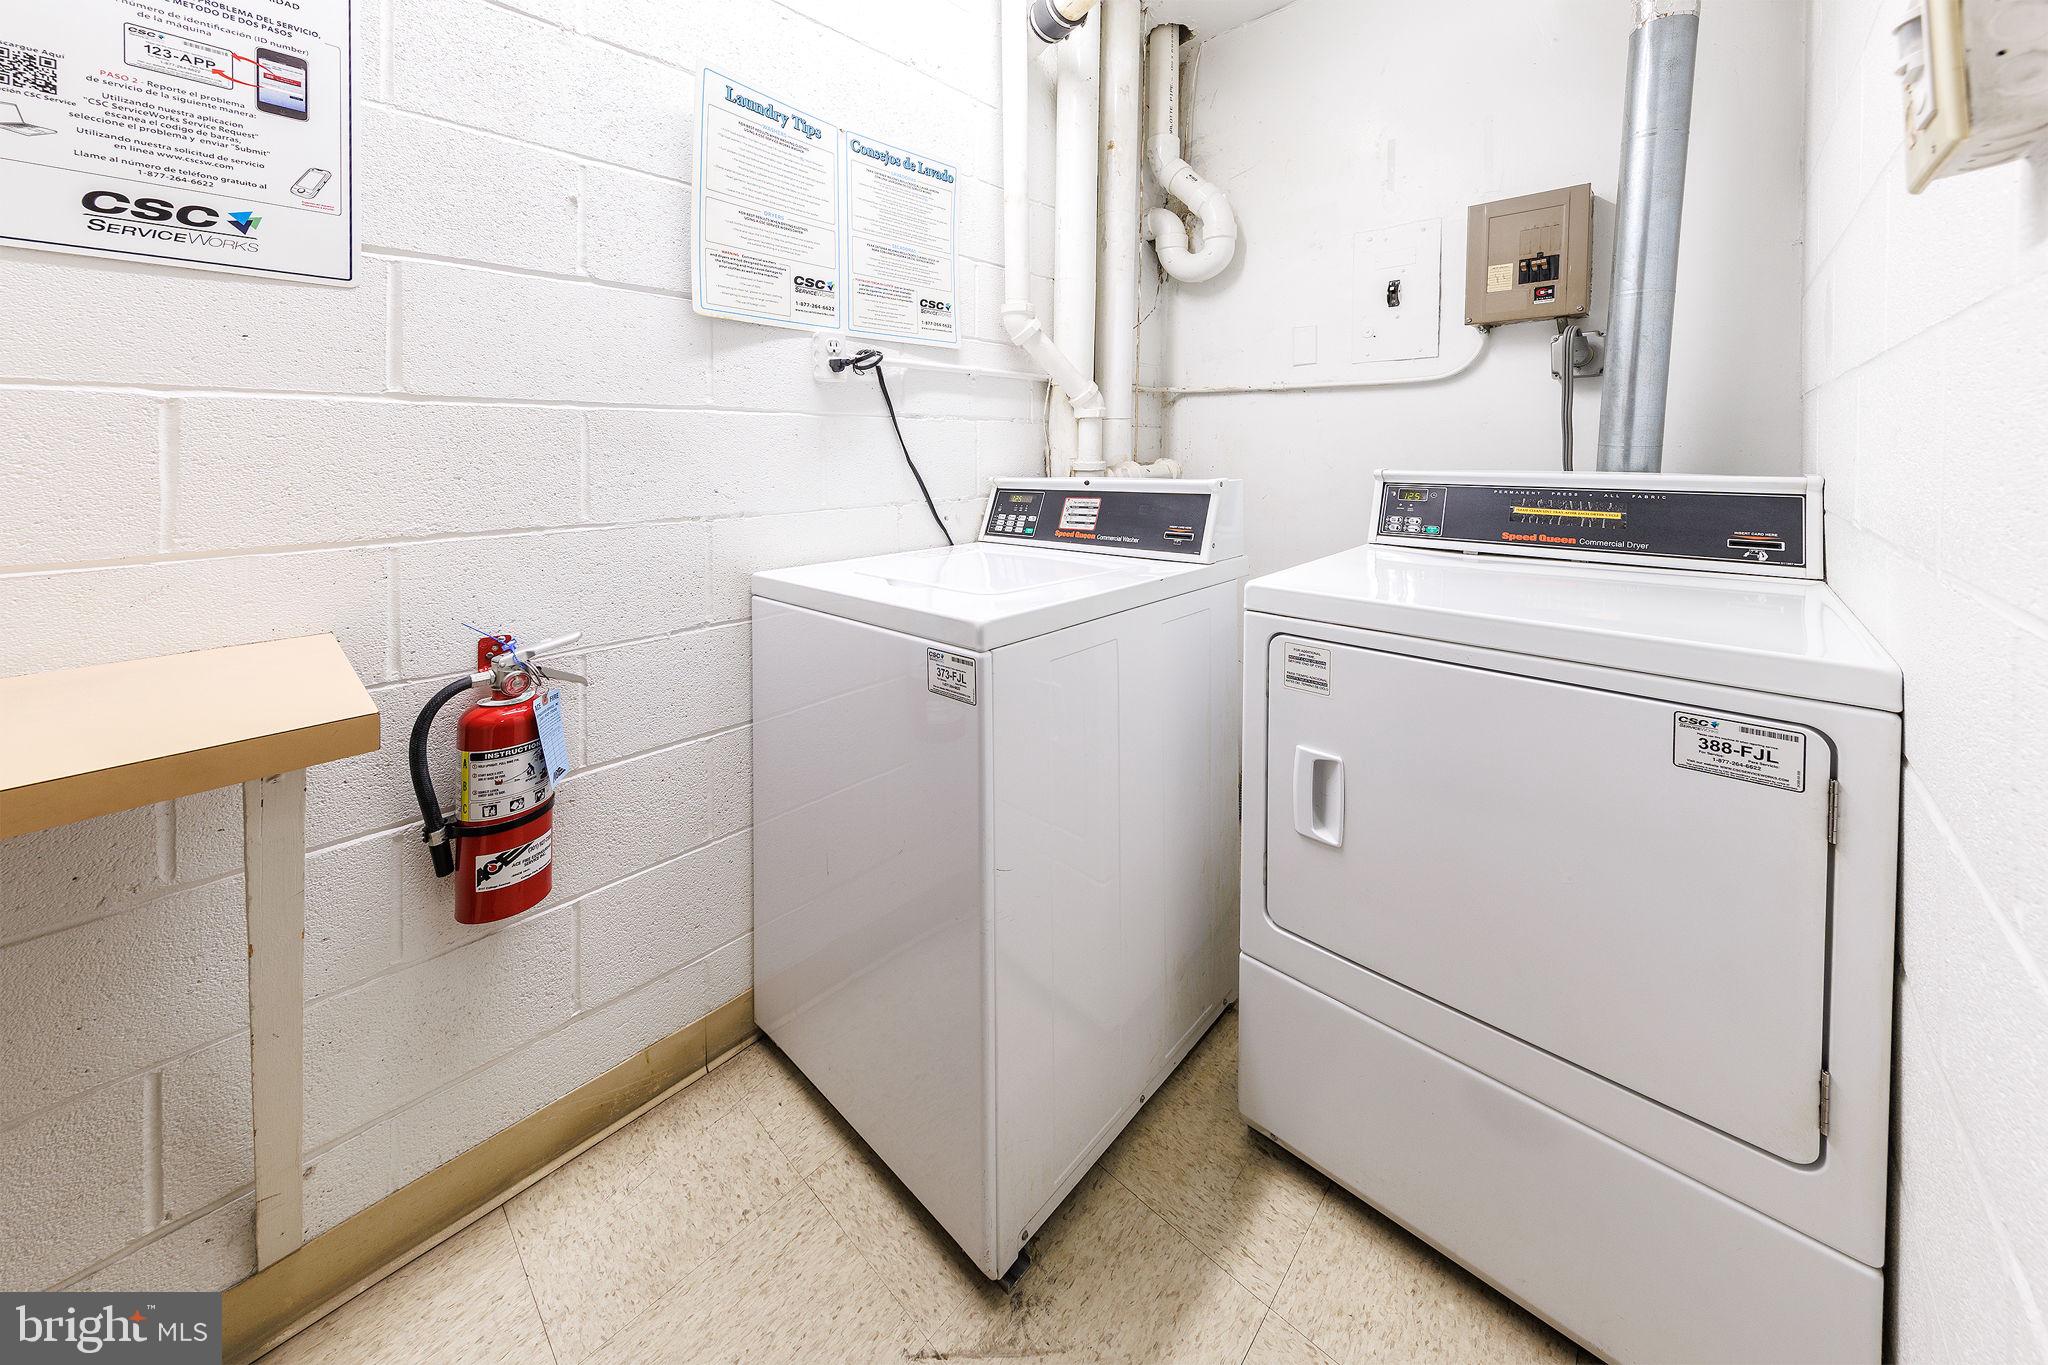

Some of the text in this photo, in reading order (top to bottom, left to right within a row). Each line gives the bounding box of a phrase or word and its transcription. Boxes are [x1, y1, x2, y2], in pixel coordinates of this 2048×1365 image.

[153, 15, 163, 23] la
[222, 12, 236, 21] DE
[238, 17, 259, 28] DOS
[261, 24, 293, 38] PASOS
[256, 14, 274, 25] DEL
[276, 20, 321, 39] SERVICIO,
[128, 26, 156, 38] CSC
[168, 11, 181, 19] de
[254, 36, 268, 44] (ID
[270, 40, 309, 56] number)
[143, 44, 216, 69] 123-APP
[24, 91, 41, 99] CSC
[44, 95, 77, 106] Service
[85, 75, 100, 83] de
[102, 80, 143, 93] servicio
[146, 89, 159, 97] de
[172, 95, 217, 110] siguiente
[219, 106, 257, 119] manera:
[99, 69, 129, 82] PASO
[147, 80, 187, 94] Reporte
[189, 90, 198, 98] el
[200, 94, 245, 109] problema
[101, 92, 155, 109] Utilizando
[157, 105, 195, 119] nuestra
[111, 102, 180, 123] ServiceWorks
[182, 118, 216, 131] Service
[725, 85, 822, 140] Laundry Tips
[68, 111, 125, 127] seleccione
[139, 125, 188, 140] problema
[199, 138, 229, 149] enviar
[104, 110, 147, 124] escanea
[196, 129, 208, 137] de
[210, 132, 241, 144] barras,
[76, 126, 131, 143] Utilizando
[133, 139, 172, 151] nuestra
[174, 146, 215, 159] solicitud
[230, 158, 265, 169] servicio
[73, 149, 107, 161] Llame
[121, 157, 162, 171] número
[163, 166, 177, 174] de
[178, 168, 219, 181] teléfono
[220, 176, 257, 188] gratuito
[157, 151, 234, 171] www.cscsw.com
[850, 139, 901, 166] Consejos
[902, 157, 916, 172] de
[917, 161, 955, 184] Lavado
[138, 169, 214, 188] 1-877-264-6622
[81, 190, 220, 228] CSC
[793, 275, 826, 290] CSC
[920, 298, 945, 310] CSC
[1055, 529, 1140, 543] Speed Queen Commercial Washer
[1501, 531, 1650, 551] Speed Queen Commercial Dryer
[936, 667, 967, 685] 373-FJL
[1678, 716, 1709, 727] CSC
[1698, 737, 1779, 764] 388-FJL
[462, 758, 468, 769] A
[462, 803, 468, 814] C
